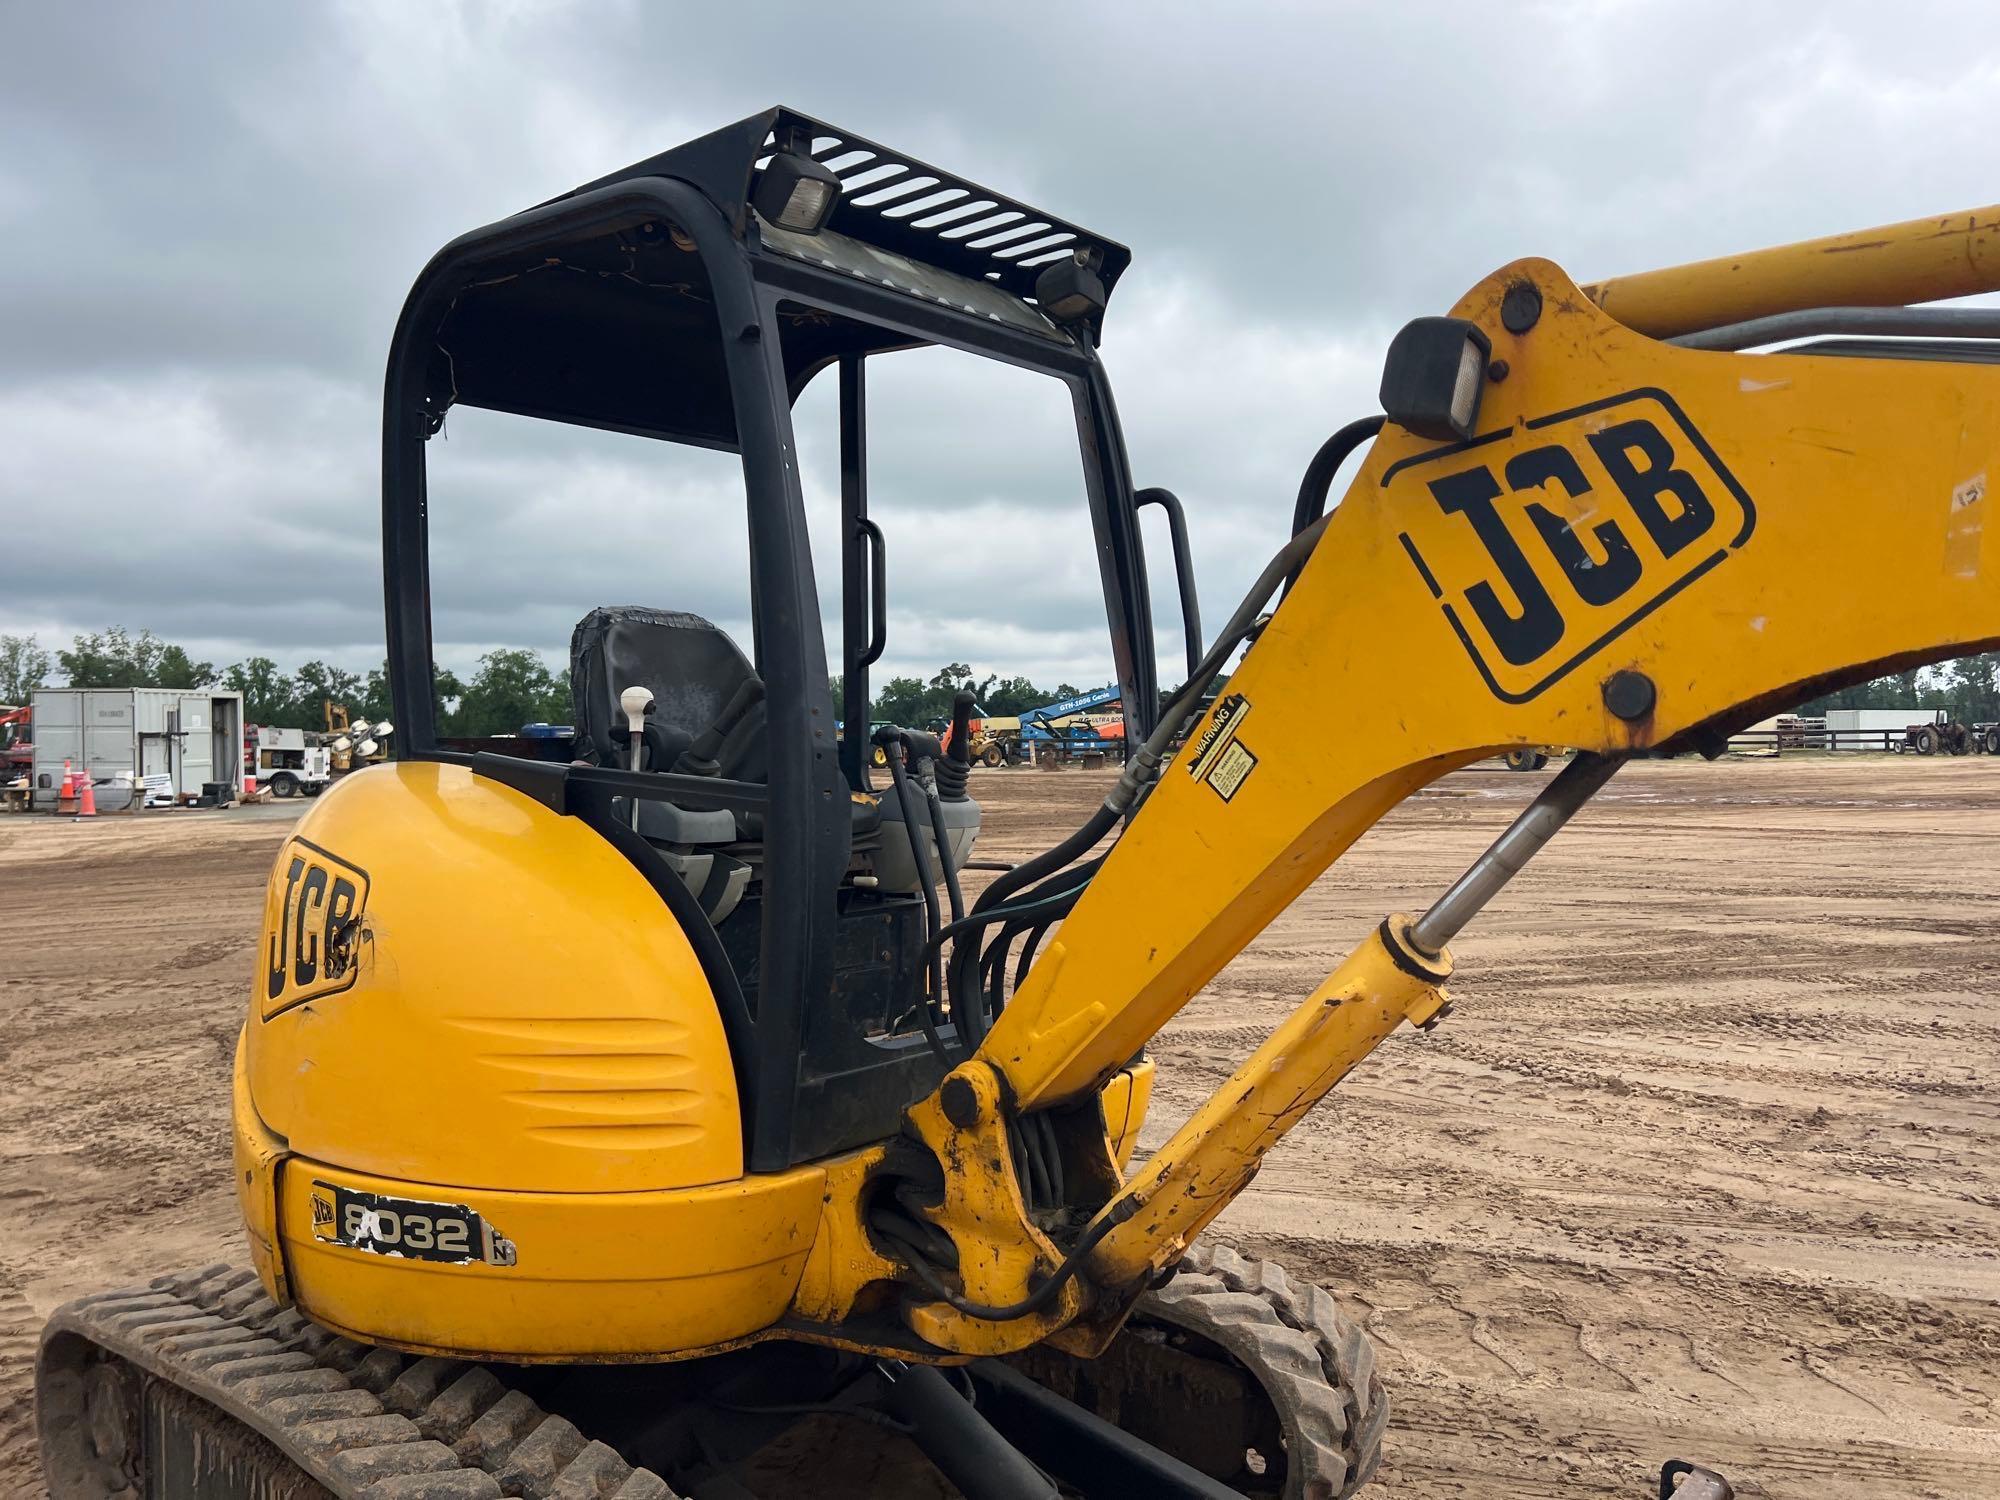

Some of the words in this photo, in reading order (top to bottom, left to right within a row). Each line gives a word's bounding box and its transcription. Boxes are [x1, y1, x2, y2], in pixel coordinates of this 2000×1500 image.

[1427, 419, 1715, 665] JCB
[1092, 692, 1110, 702] Genie
[1194, 708, 1230, 757] WARNING
[269, 858, 357, 999] JCB
[313, 1197, 333, 1222] JCB
[345, 1203, 470, 1252] 8032
